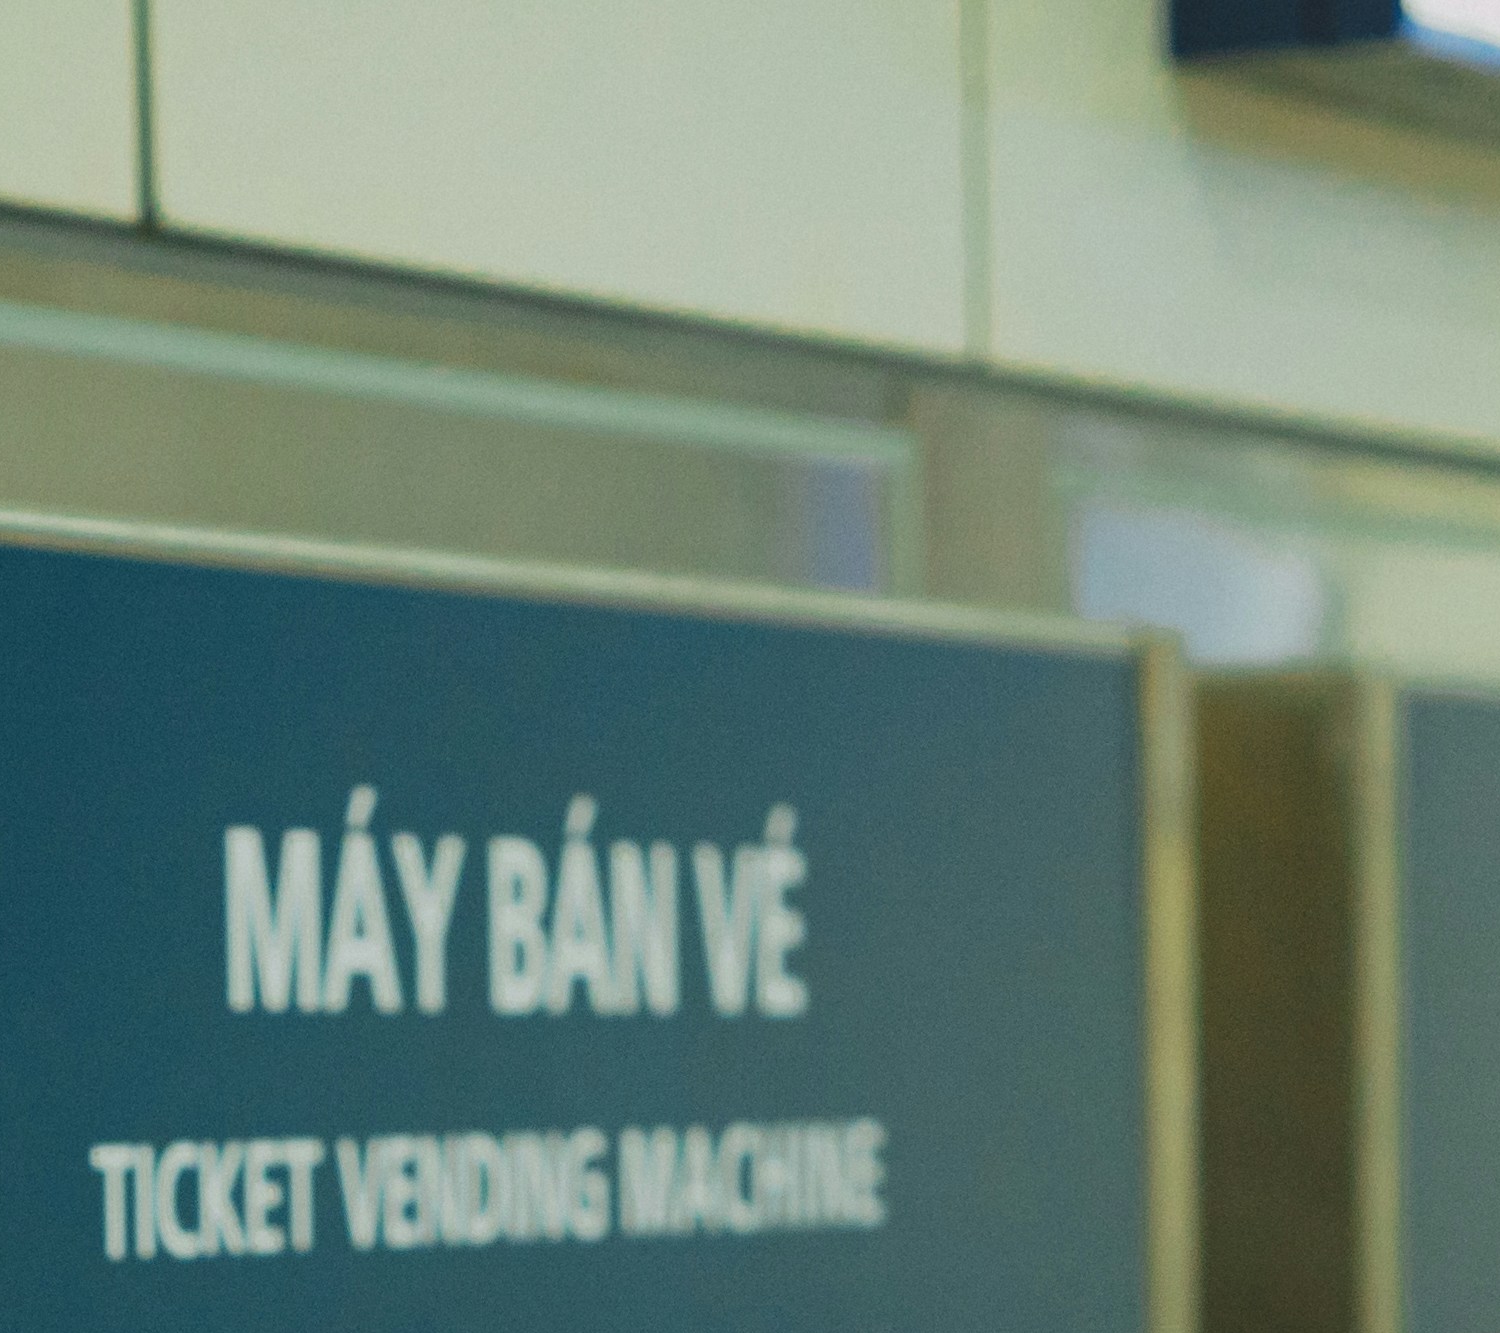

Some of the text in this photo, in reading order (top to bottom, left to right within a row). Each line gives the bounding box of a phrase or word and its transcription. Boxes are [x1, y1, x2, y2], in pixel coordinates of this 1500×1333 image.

[223, 783, 809, 1019] MÁY BÁN VÉ
[90, 1115, 887, 1260] TICKET VENDING MACHINE
